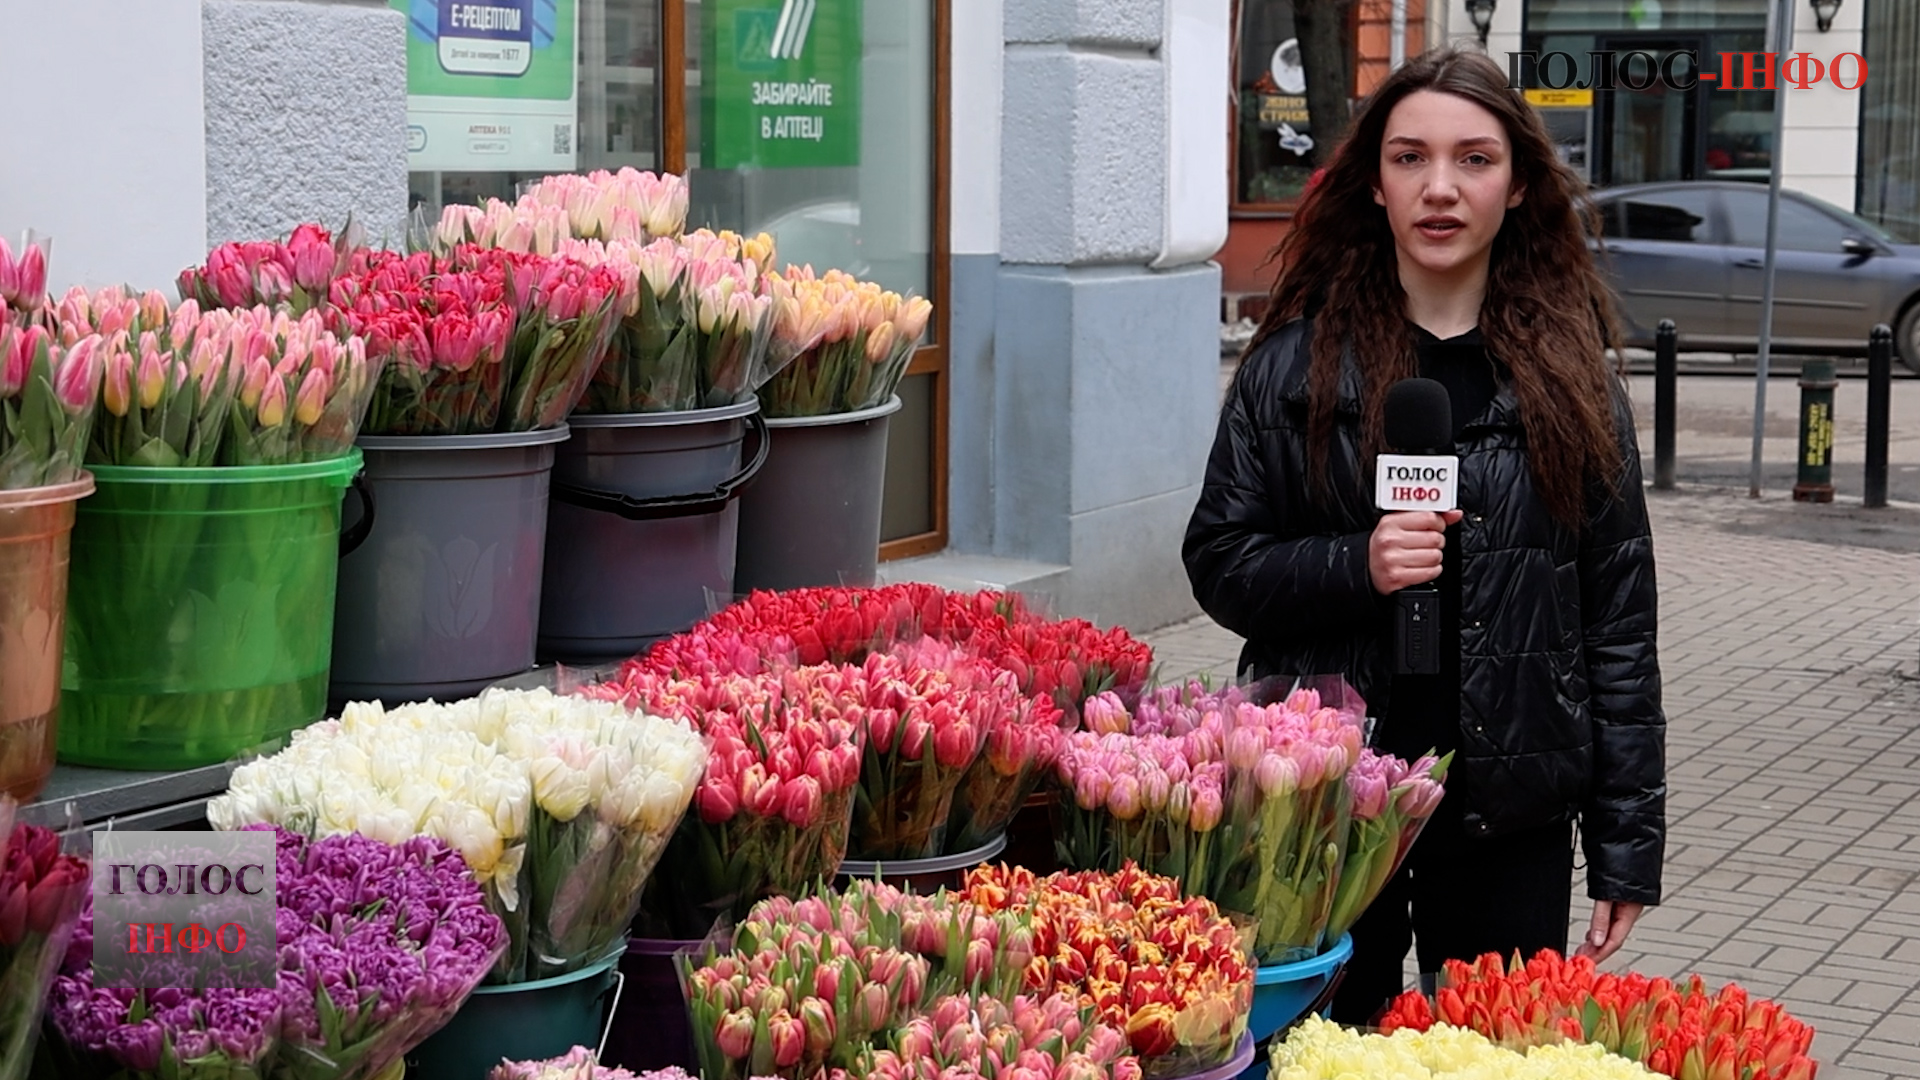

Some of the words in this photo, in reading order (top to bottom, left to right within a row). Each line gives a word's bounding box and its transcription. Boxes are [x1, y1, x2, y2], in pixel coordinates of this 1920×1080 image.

[451, 4, 521, 31] Е-РЕЦЕПТОМ
[502, 48, 520, 61] 1677
[752, 78, 832, 106] ЗАБИРАЙТЕ
[468, 125, 497, 135] АПТЕКА
[761, 116, 772, 139] В
[774, 116, 823, 142] АПТЕЦІ
[1387, 466, 1448, 482] ГОЛОС
[1392, 486, 1441, 501] ІНФО
